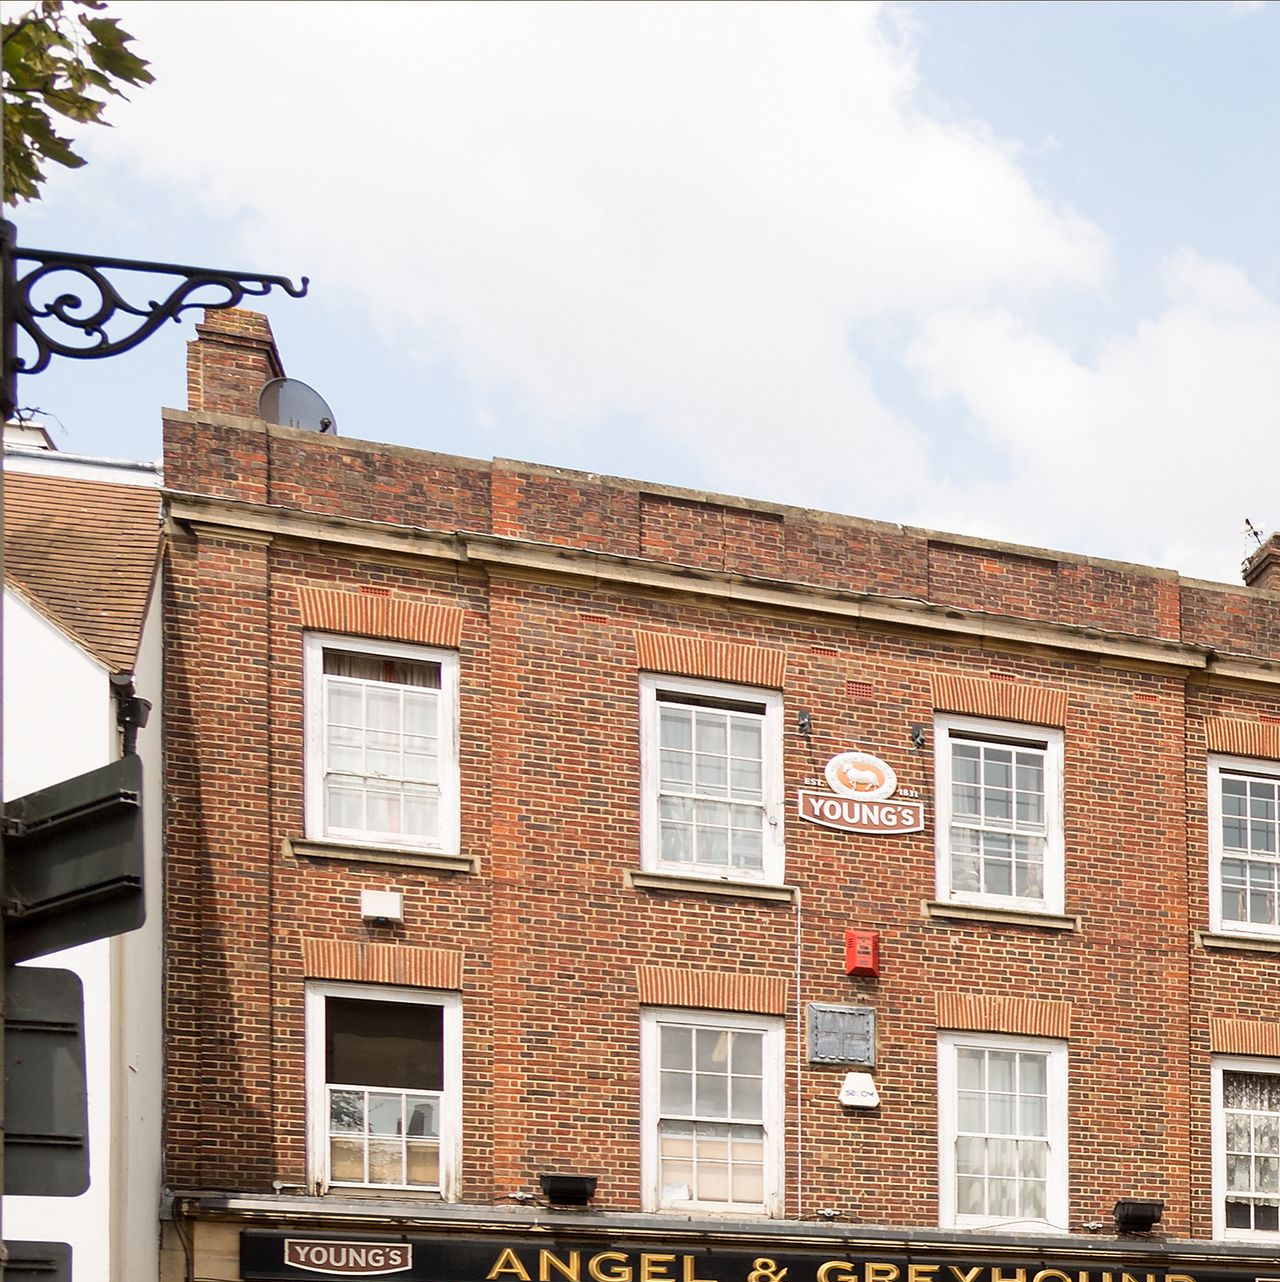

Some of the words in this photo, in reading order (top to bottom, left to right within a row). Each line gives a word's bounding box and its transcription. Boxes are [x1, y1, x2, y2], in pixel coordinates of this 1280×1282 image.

[804, 777, 824, 786] EST.
[808, 798, 915, 826] YOUNG'S
[294, 1246, 402, 1268] YOUNG'S
